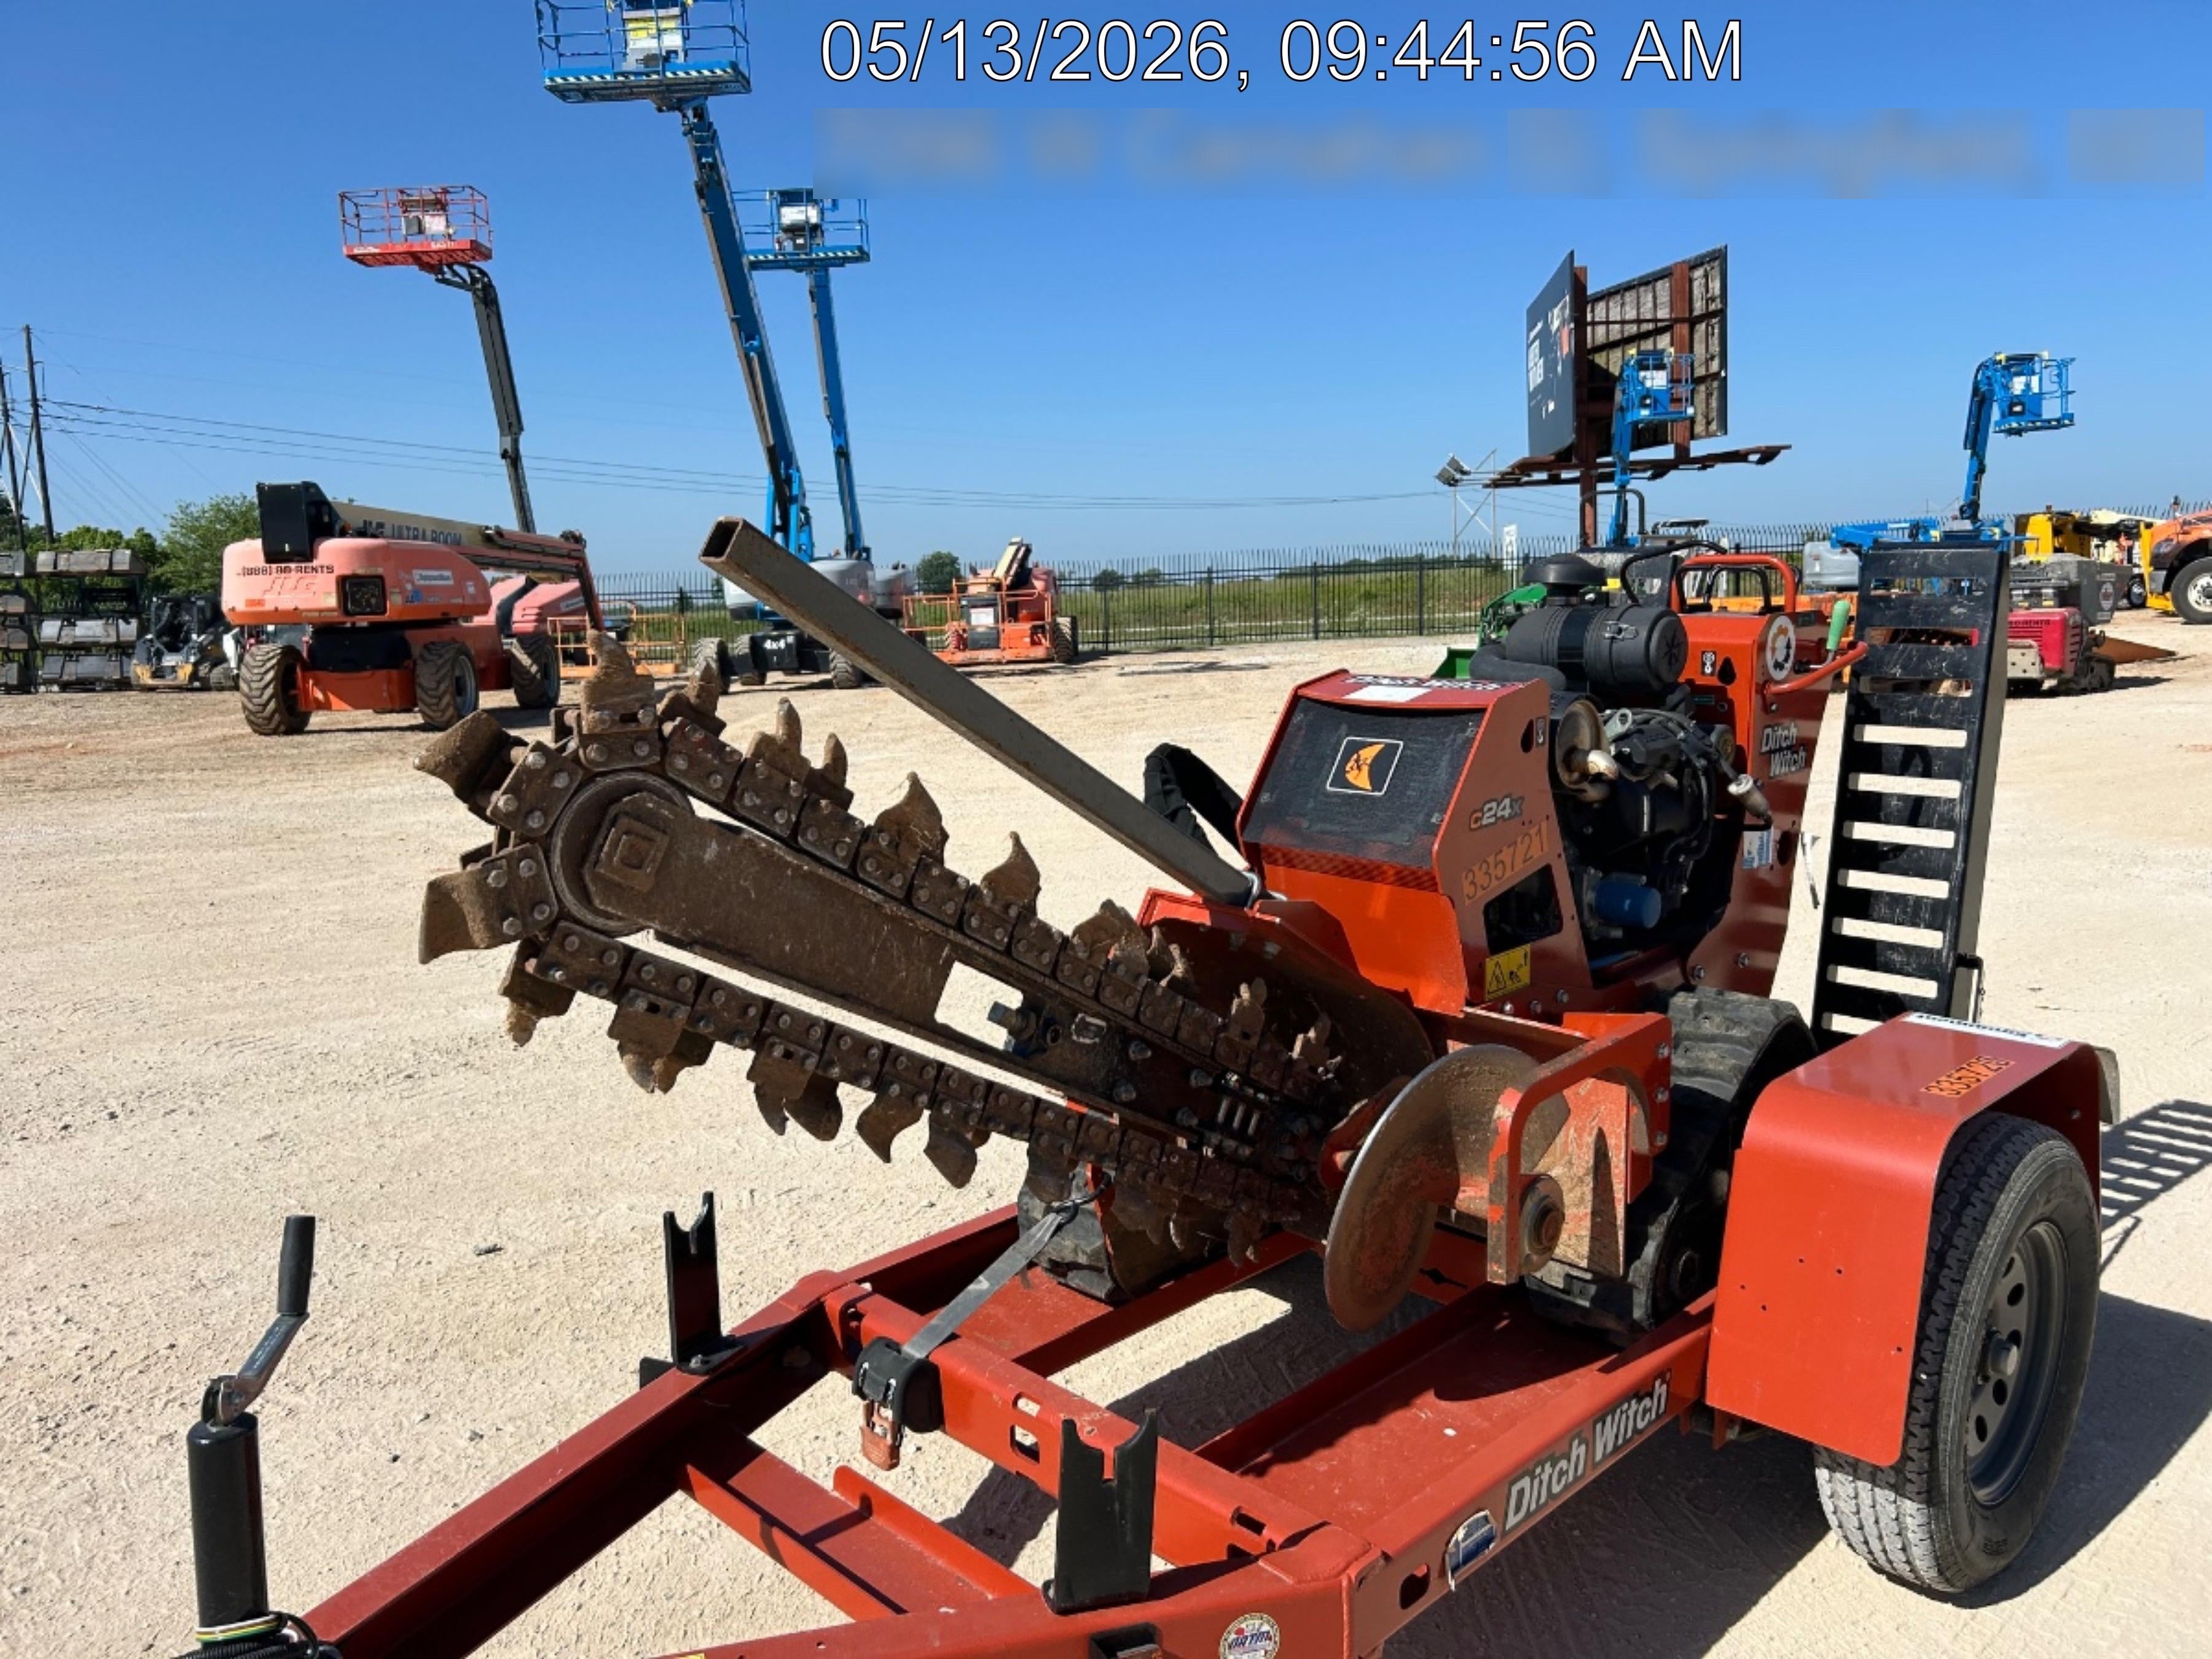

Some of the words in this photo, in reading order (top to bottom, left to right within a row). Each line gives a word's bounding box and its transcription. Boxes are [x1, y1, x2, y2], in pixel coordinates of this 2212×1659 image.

[1760, 721, 1798, 753] Ditch
[1770, 746, 1806, 777] Witch
[1464, 820, 1544, 900] 335721
[1505, 1438, 1586, 1531] Ditch
[1594, 1378, 1668, 1463] Witch
